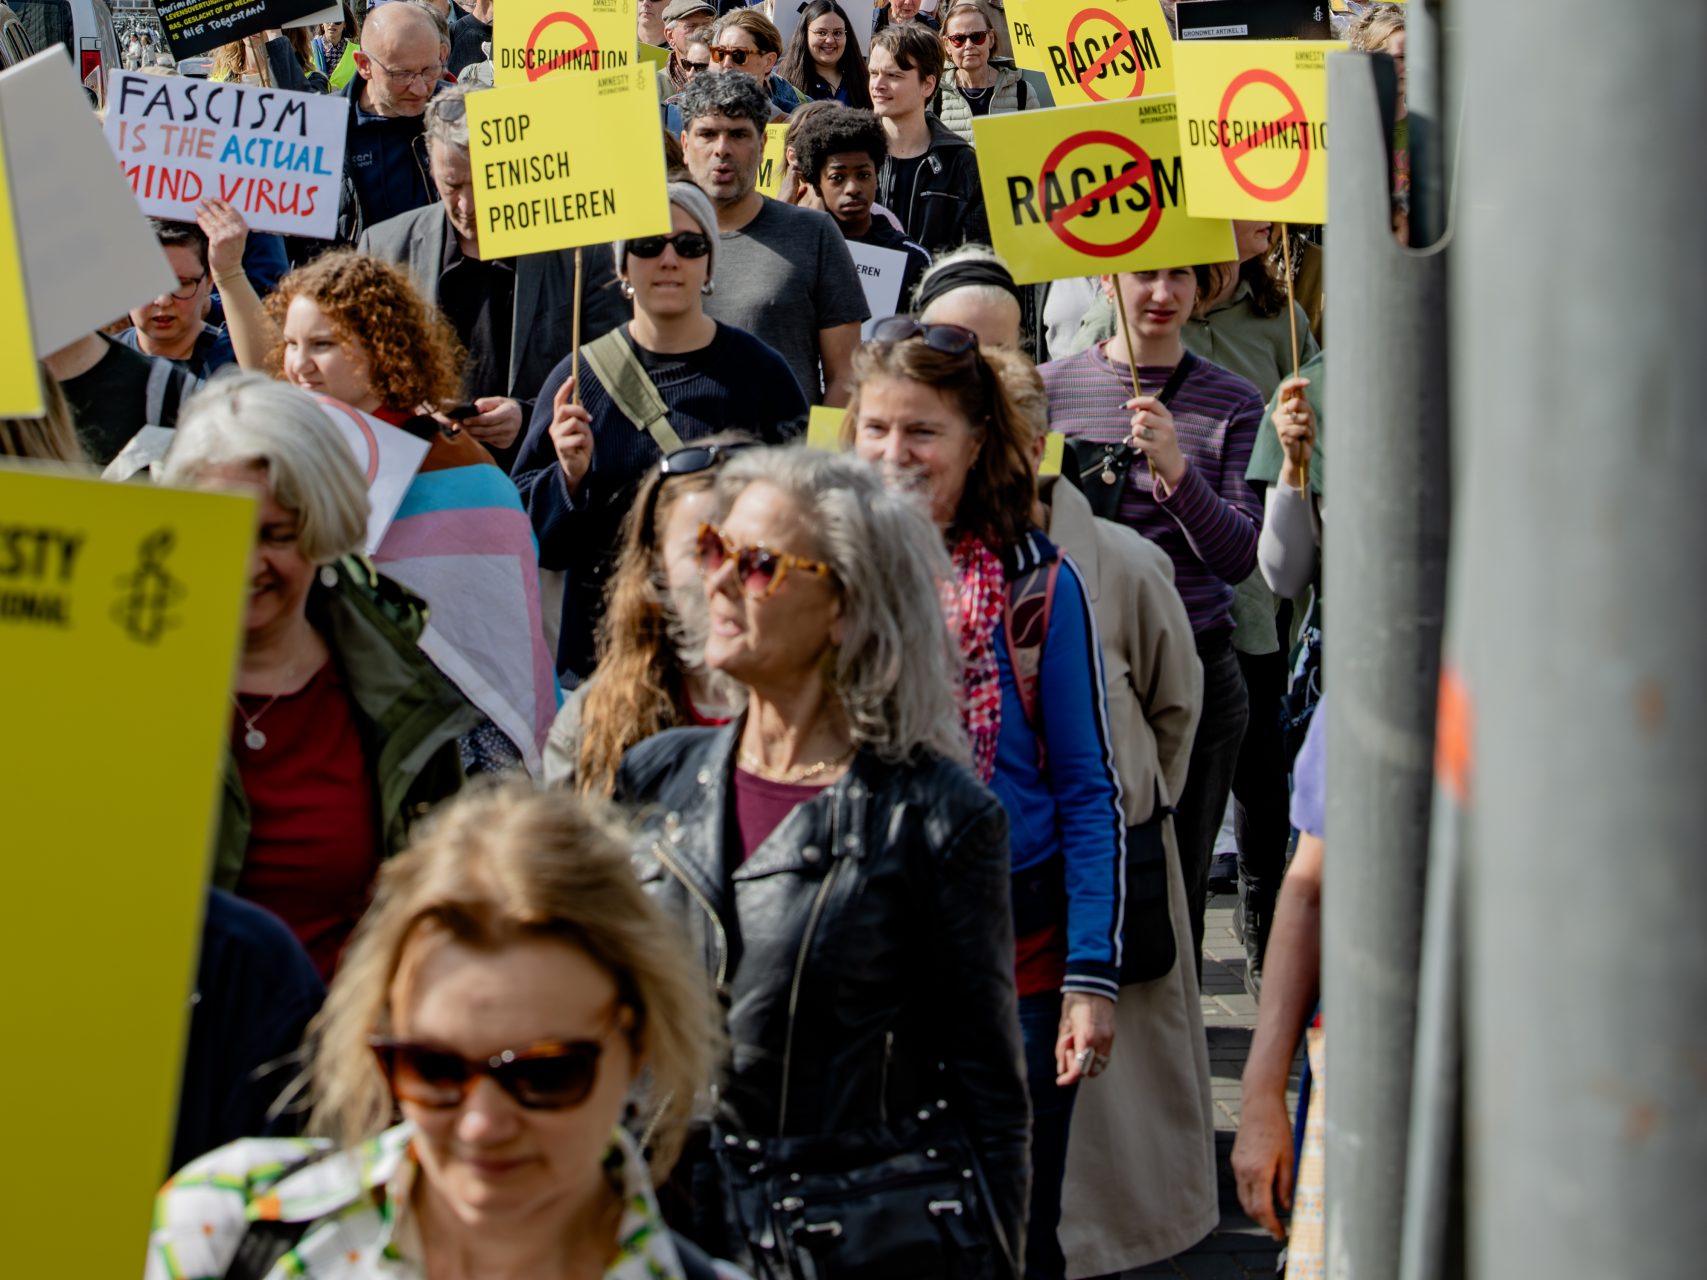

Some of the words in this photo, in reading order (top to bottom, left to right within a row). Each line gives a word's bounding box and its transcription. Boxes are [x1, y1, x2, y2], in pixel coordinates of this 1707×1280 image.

[184, 10, 214, 25] GESLACHT
[224, 3, 233, 11] OP
[593, 0, 617, 7] AMNESTY
[183, 24, 205, 39] NIET
[1184, 29, 1215, 38] GRONDWET
[502, 48, 628, 71] DISCRIMINATION
[1048, 27, 1161, 87] RACISM
[598, 75, 629, 88] AMNESTY
[120, 76, 307, 137] FASCISM
[119, 121, 147, 154] IS
[160, 124, 217, 160] THE
[220, 134, 333, 176] ACTUAL
[481, 114, 531, 147] STOP
[485, 151, 570, 190] ETNISCH
[219, 174, 319, 217] VIRUS
[1007, 156, 1186, 226] RACISM
[490, 188, 616, 233] PROFILEREN
